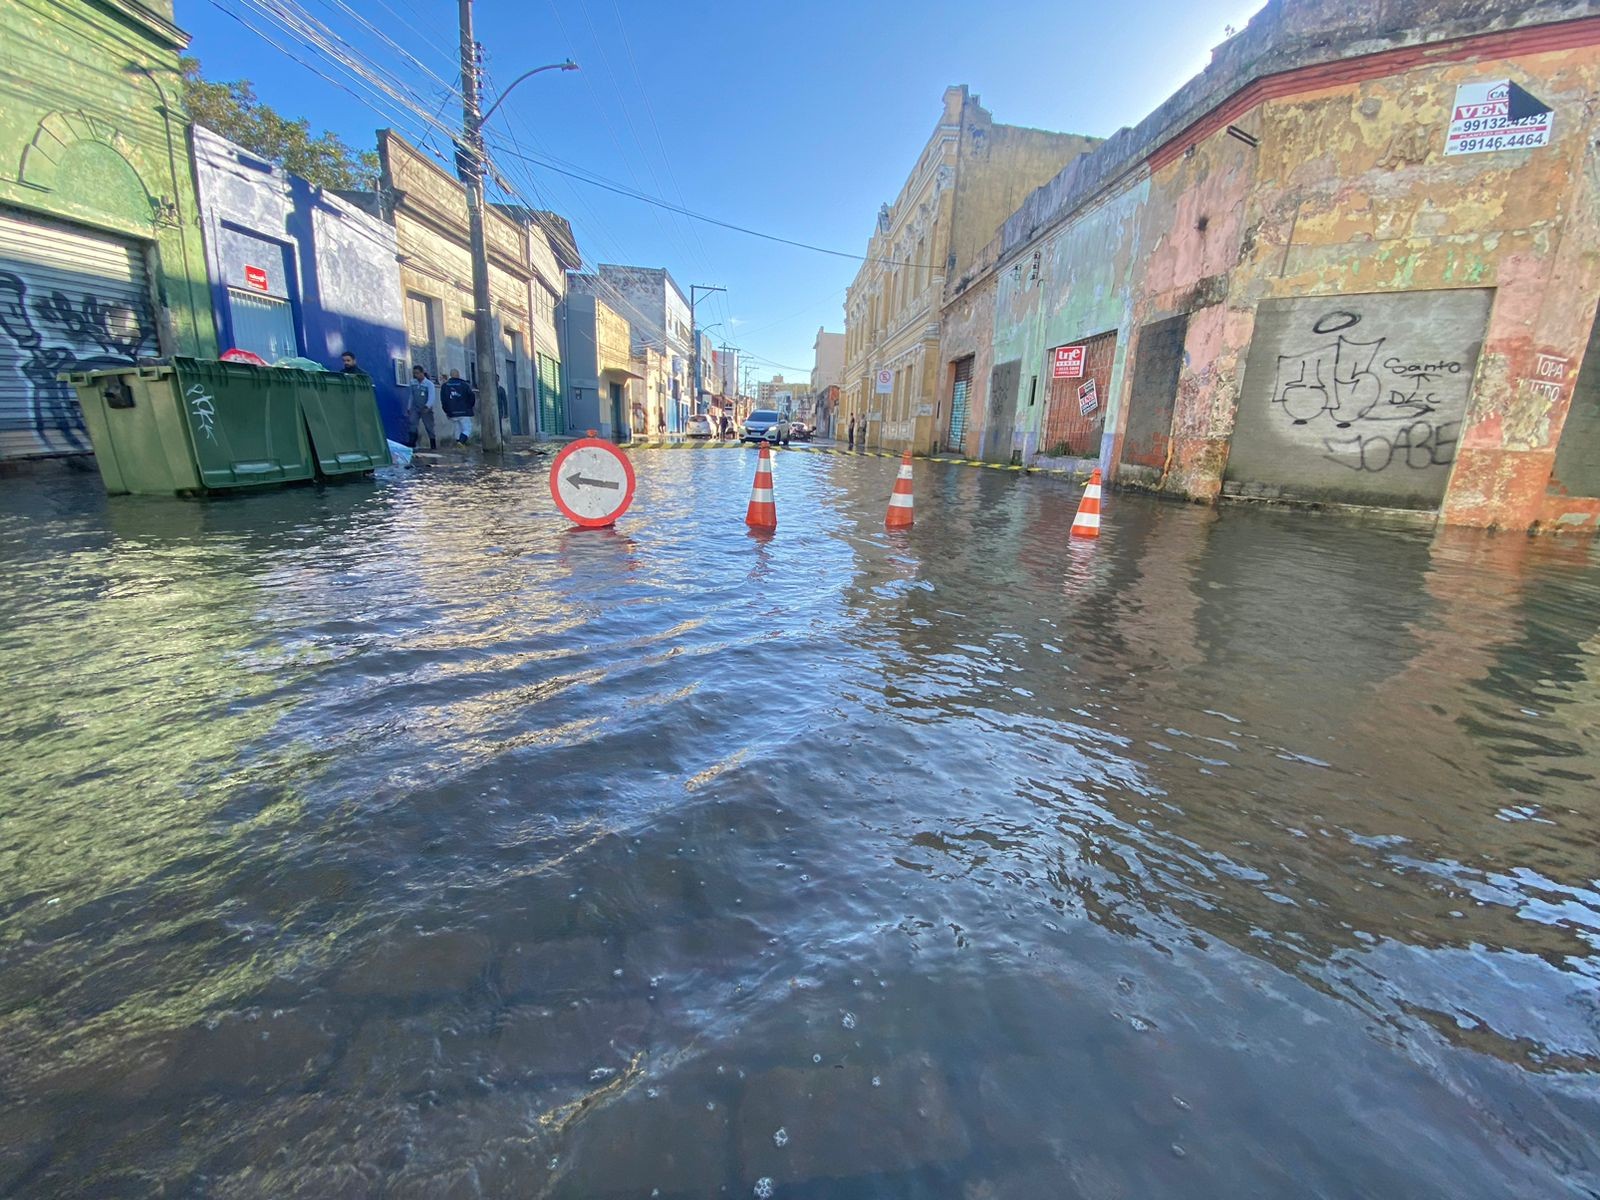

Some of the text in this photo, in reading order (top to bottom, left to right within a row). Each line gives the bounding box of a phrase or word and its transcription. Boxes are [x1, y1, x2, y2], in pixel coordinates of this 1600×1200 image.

[1463, 113, 1548, 132] 99132.4252
[1460, 133, 1544, 151] 99146.4464
[1384, 357, 1462, 374] Santo
[1536, 353, 1568, 379] TOPA
